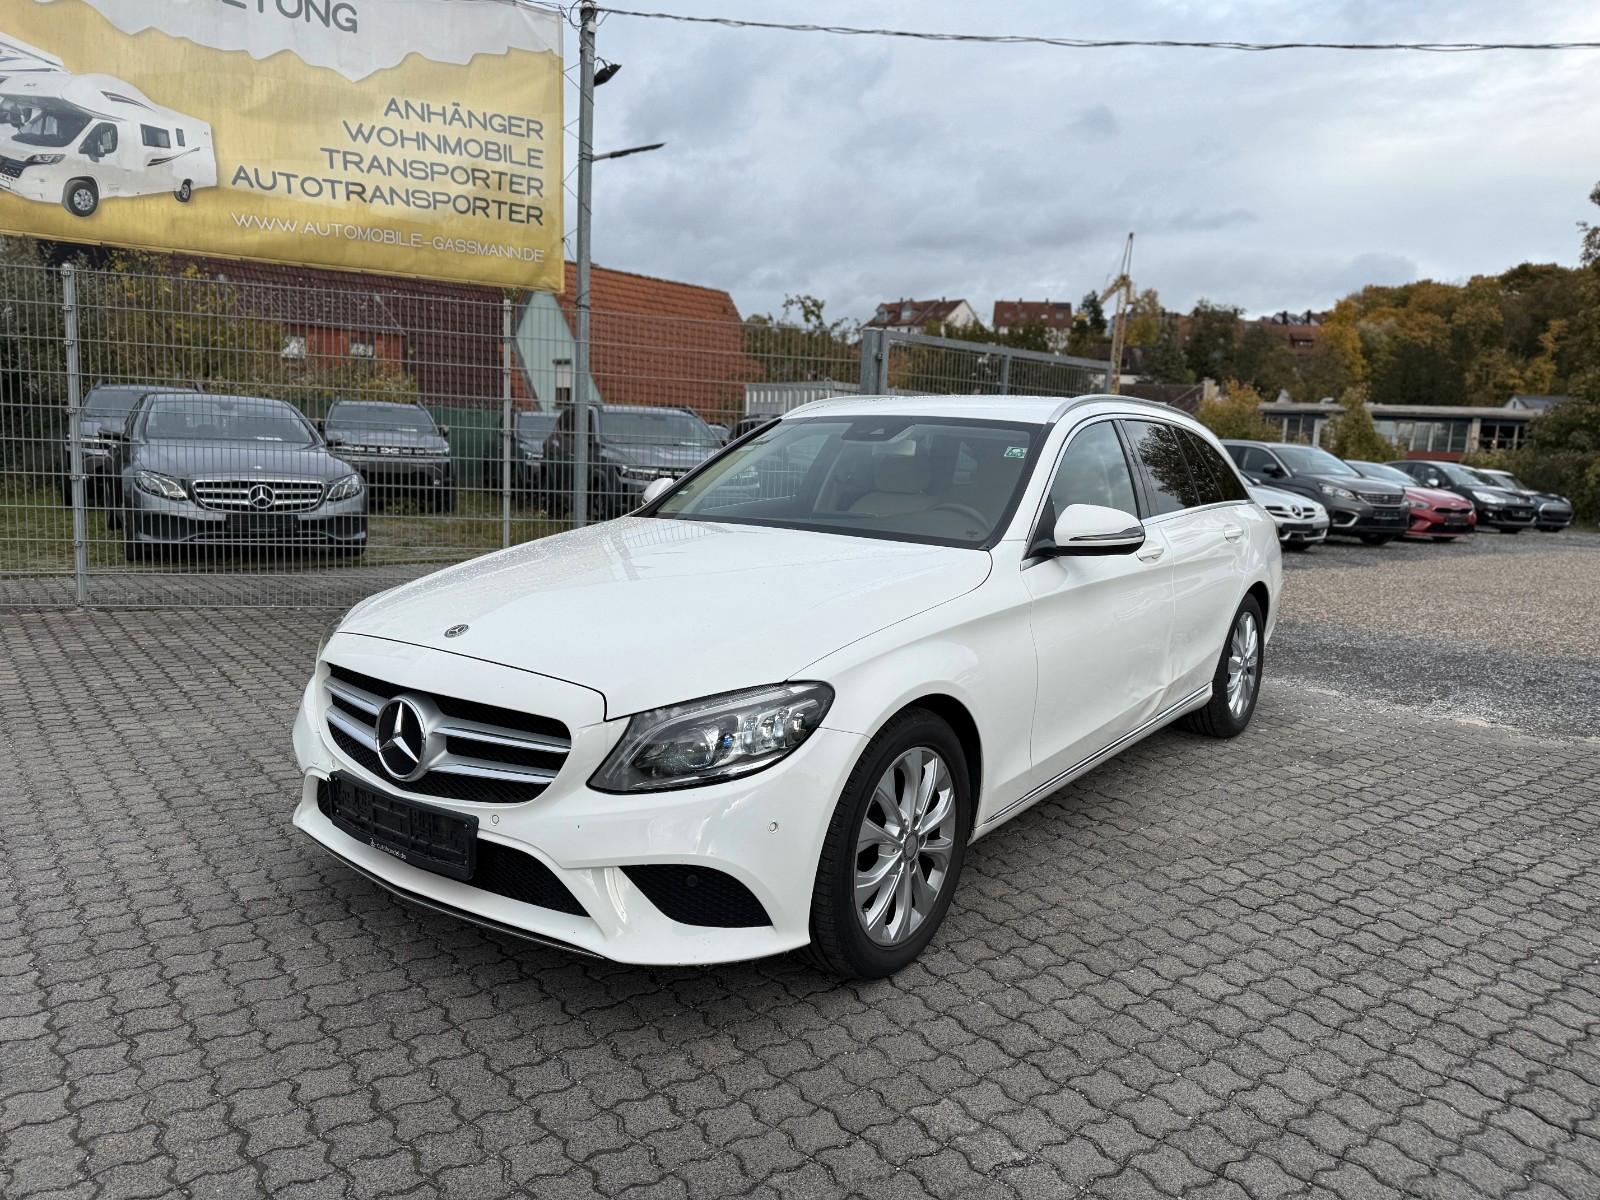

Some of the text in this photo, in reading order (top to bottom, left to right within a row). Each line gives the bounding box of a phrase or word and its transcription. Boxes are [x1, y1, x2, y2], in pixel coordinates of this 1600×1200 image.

[343, 119, 544, 169] WOHNMOBILE
[384, 97, 544, 141] ANHÄNGER
[231, 165, 544, 226] AUTOTRANSPORTER
[320, 147, 544, 198] TRANSPORTER
[231, 212, 545, 263] WWW.AUTOMOBILE-GASSMANN.DE
